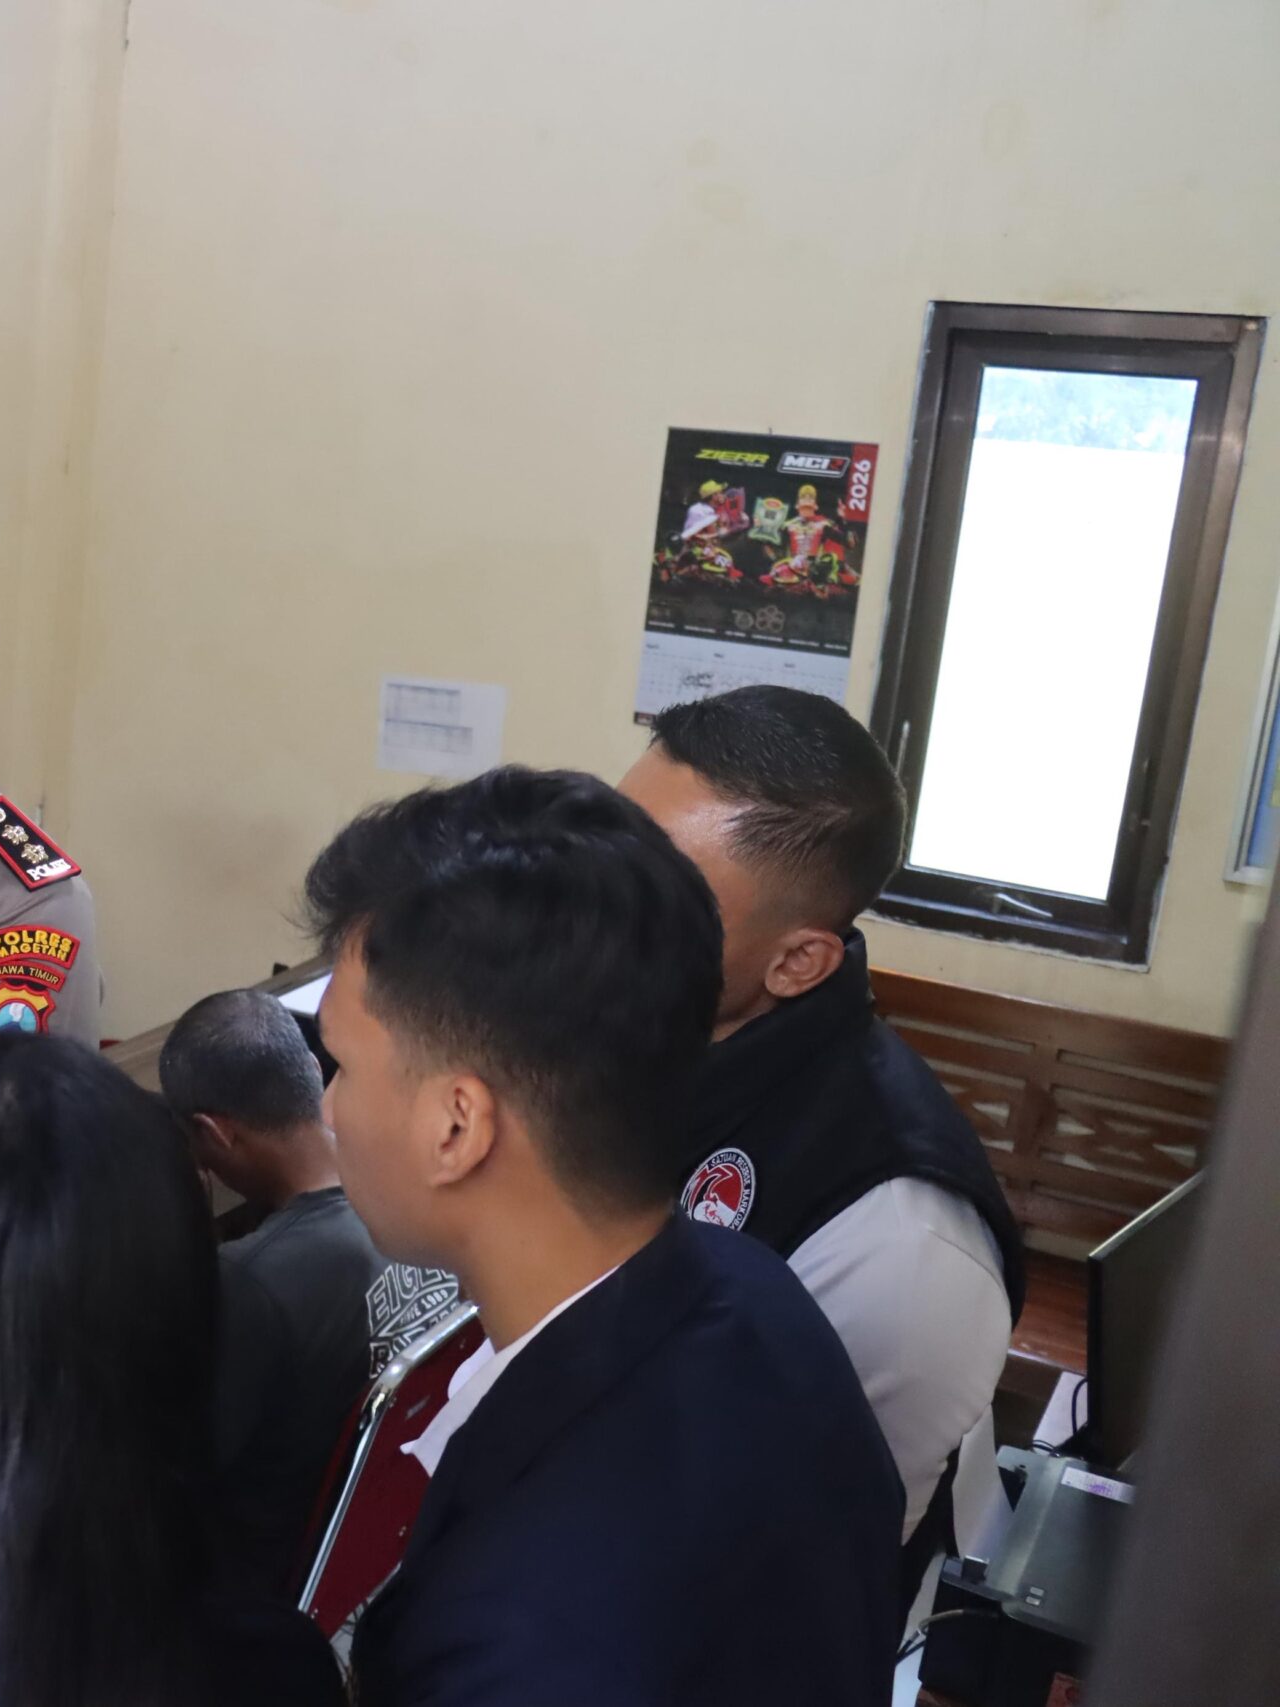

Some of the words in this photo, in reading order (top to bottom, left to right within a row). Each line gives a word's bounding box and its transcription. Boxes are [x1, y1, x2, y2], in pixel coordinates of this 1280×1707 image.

[849, 459, 871, 512] 2026
[29, 967, 59, 984] TIMUR
[710, 1152, 737, 1167] SATUAN
